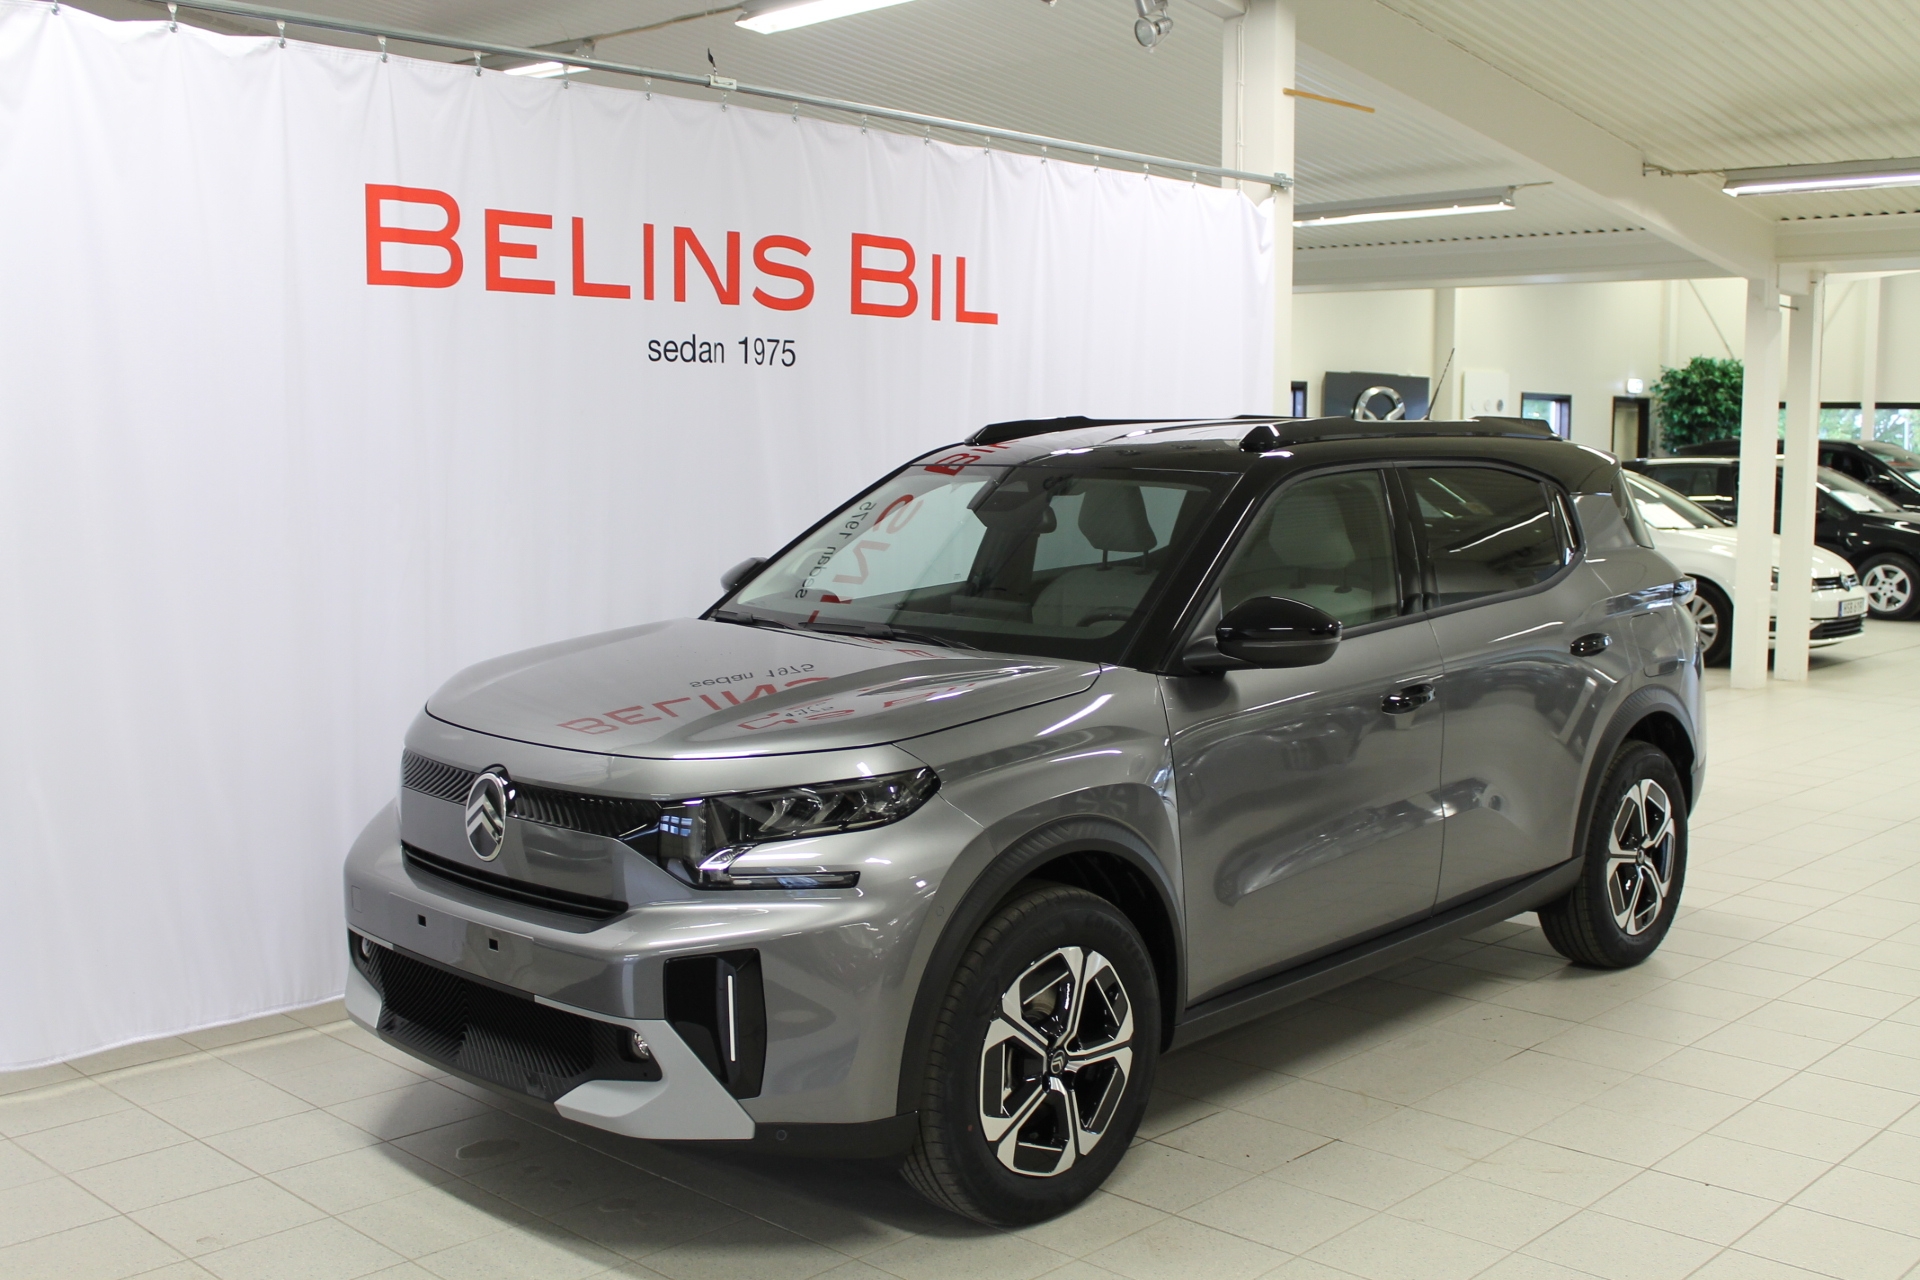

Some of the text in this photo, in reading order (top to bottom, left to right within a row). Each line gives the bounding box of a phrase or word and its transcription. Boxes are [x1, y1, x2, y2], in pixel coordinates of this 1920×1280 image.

[365, 184, 998, 325] BELINS BIL
[648, 334, 796, 367] sedan 1975
